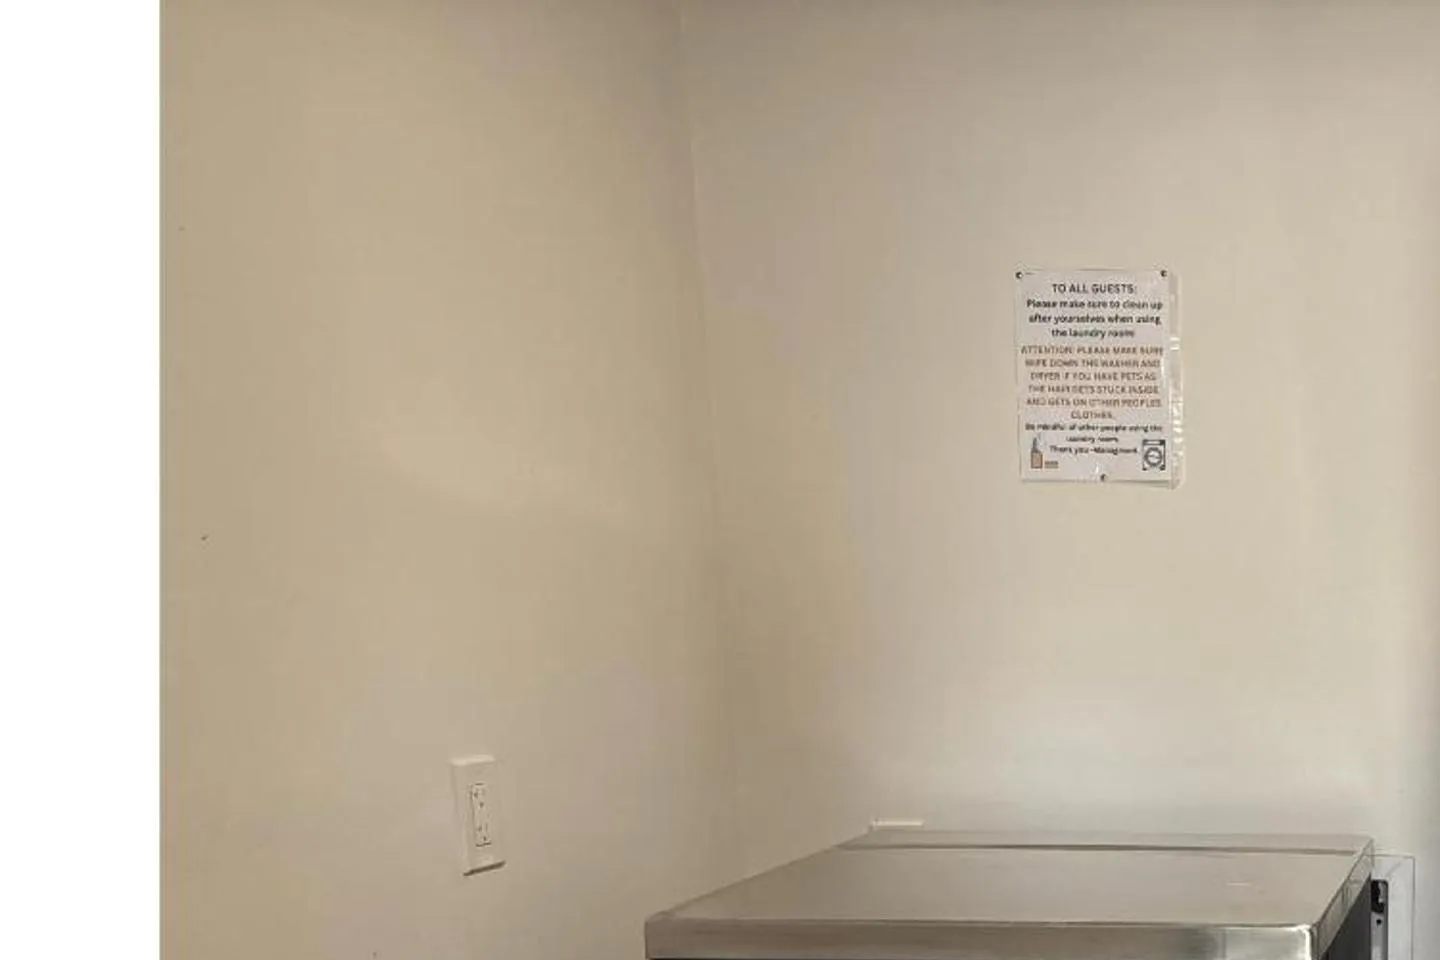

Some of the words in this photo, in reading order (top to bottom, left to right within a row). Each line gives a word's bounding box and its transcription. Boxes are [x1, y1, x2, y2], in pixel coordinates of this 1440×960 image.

[1052, 284, 1066, 293] TO
[1069, 284, 1089, 294] ALL
[1026, 299, 1058, 309] Please
[1060, 300, 1085, 309] make
[1087, 301, 1108, 309] sure
[1110, 300, 1120, 309] to
[1151, 301, 1163, 311] up
[1028, 313, 1052, 323] after
[1053, 313, 1105, 325] yourselves
[1107, 313, 1133, 323] when
[1051, 328, 1067, 337] the
[1069, 328, 1106, 339] laundry
[1049, 358, 1078, 368] DOWN
[1072, 372, 1091, 381] YOU
[1093, 372, 1118, 381] HAVE
[1120, 372, 1144, 381] PETS
[1096, 385, 1126, 394] STUCK
